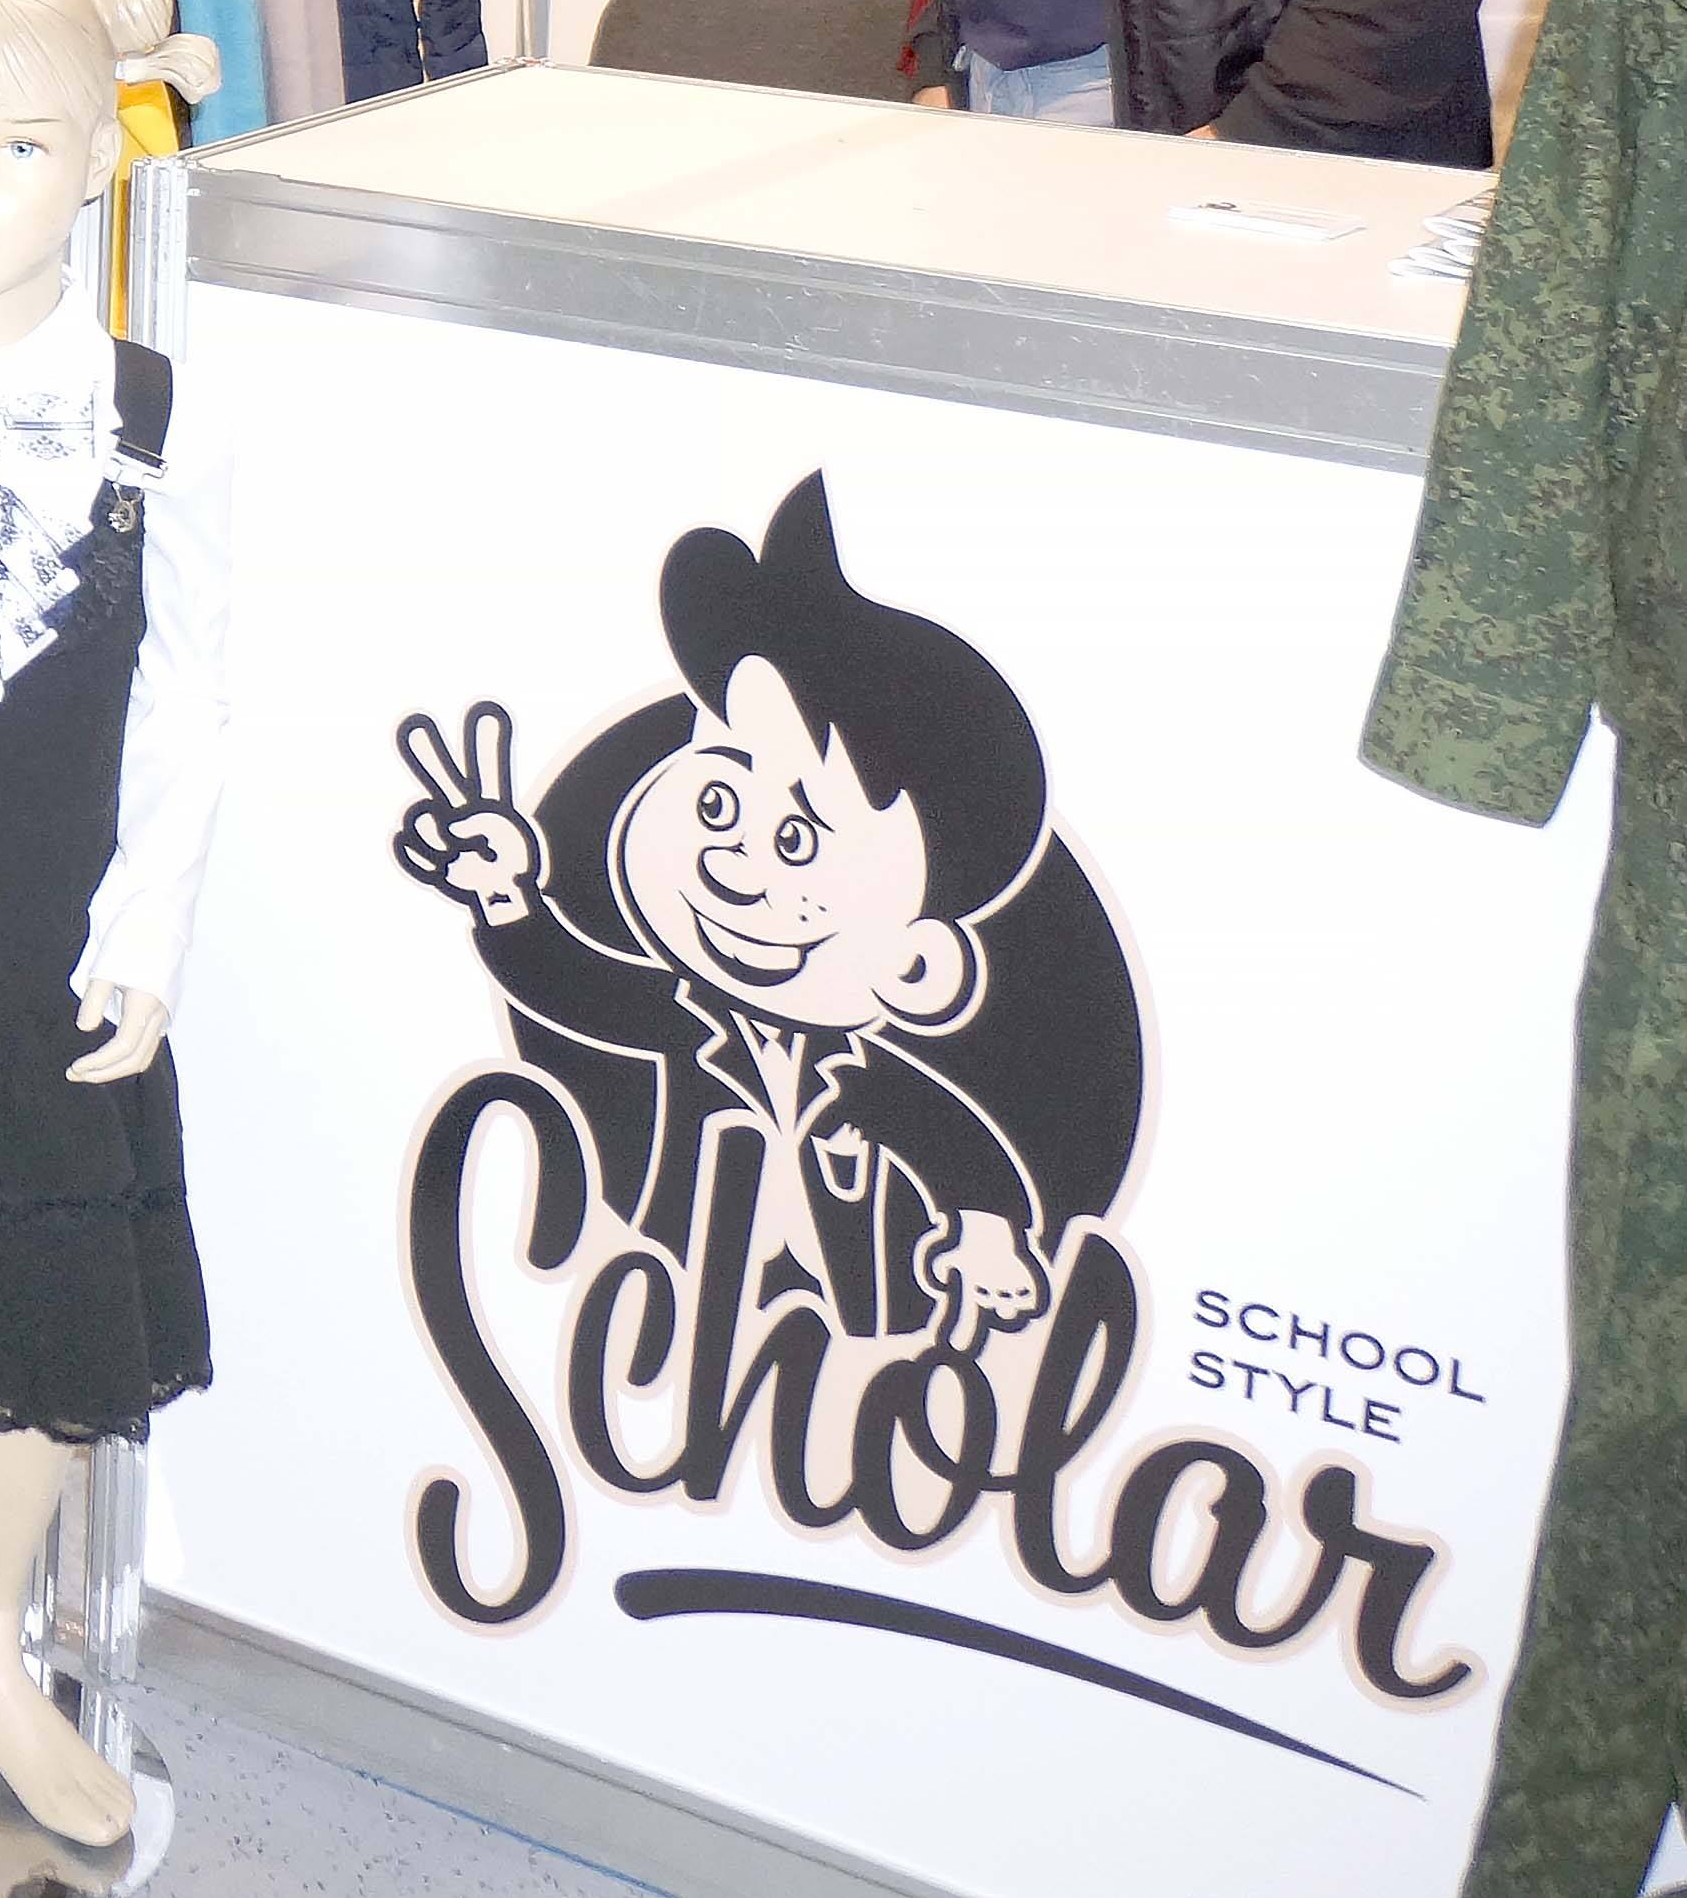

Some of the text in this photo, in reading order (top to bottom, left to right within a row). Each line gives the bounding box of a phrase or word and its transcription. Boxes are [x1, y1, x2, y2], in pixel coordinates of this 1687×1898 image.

[410, 1071, 1472, 1699] Scholar
[1187, 1351, 1404, 1443] STYLE
[1193, 1290, 1487, 1405] SCHOOL
